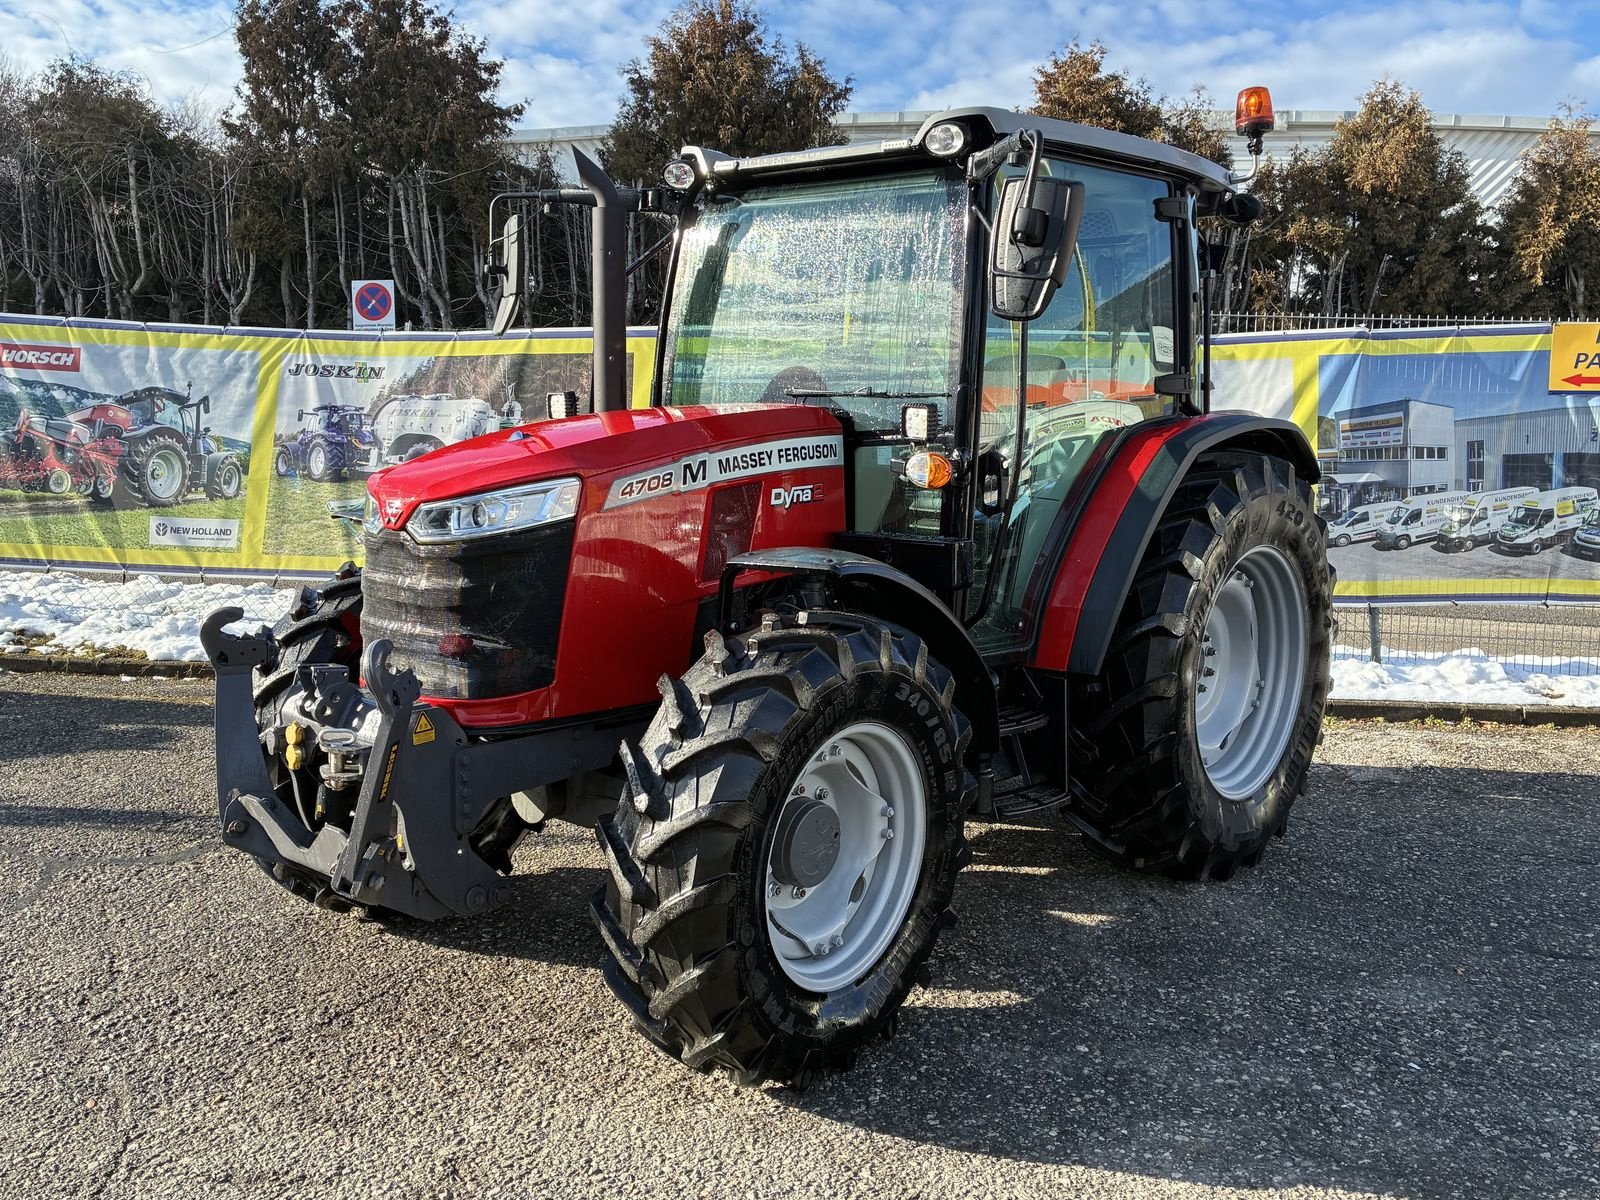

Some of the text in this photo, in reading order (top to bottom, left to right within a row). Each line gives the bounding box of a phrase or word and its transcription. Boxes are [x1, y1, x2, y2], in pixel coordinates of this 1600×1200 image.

[1, 349, 75, 366] HORSCH
[288, 363, 386, 379] JOSKIN
[619, 443, 838, 500] 4708 M MASSEY FERGUSON
[170, 526, 232, 536] NEW HOLLAND
